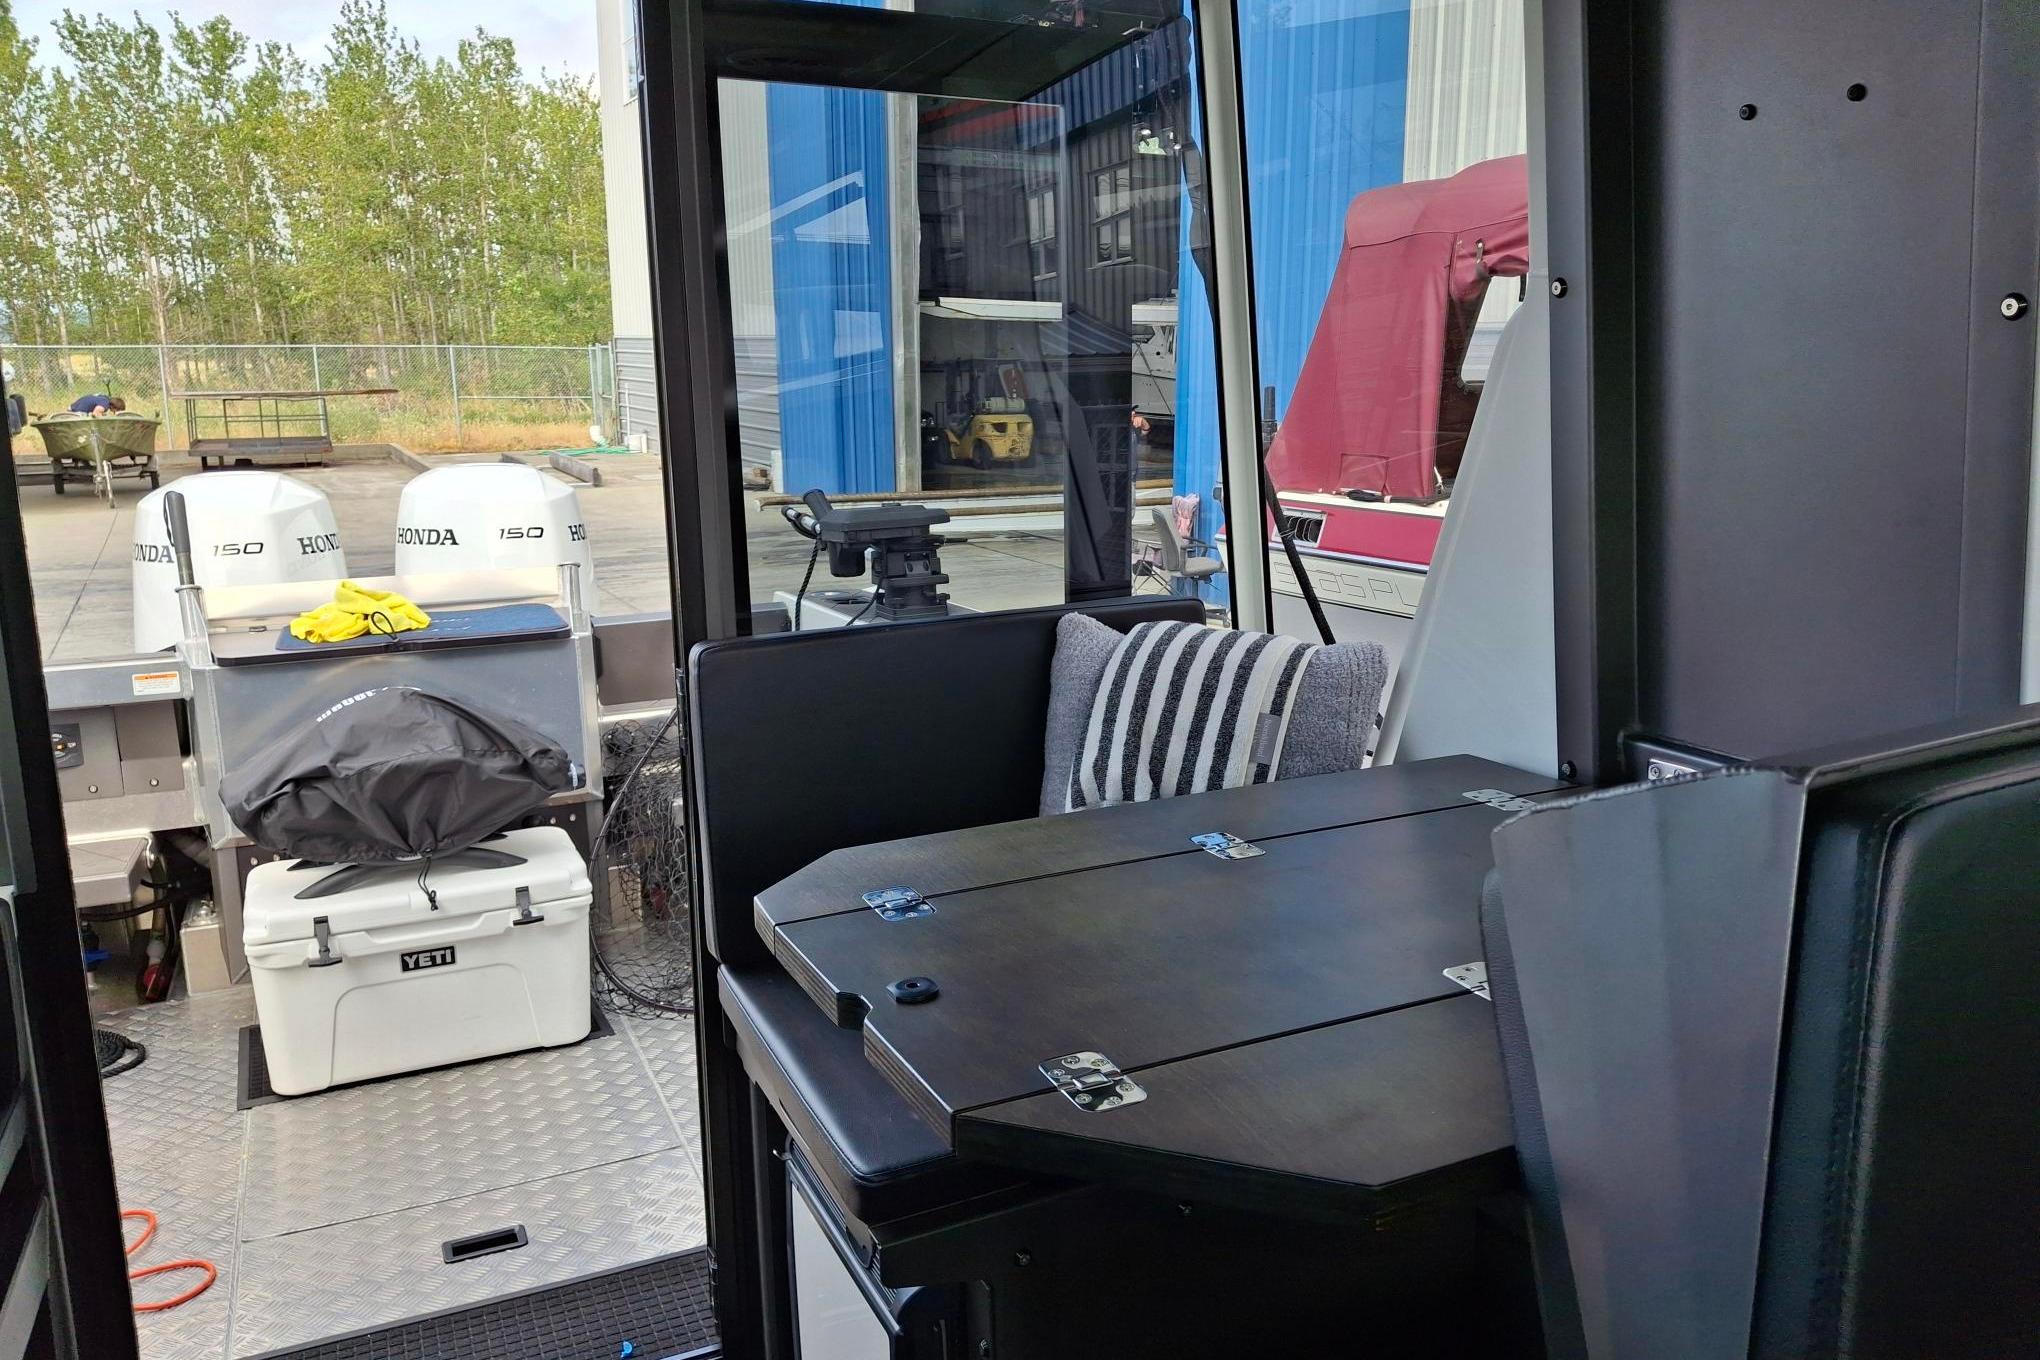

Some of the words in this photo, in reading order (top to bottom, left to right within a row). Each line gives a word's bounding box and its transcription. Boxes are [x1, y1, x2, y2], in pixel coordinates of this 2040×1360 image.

[397, 527, 460, 546] HONDA
[499, 526, 544, 540] 150
[134, 543, 175, 564] ONDA
[213, 542, 264, 557] 150
[297, 533, 341, 555] HON
[403, 949, 451, 969] YETI
